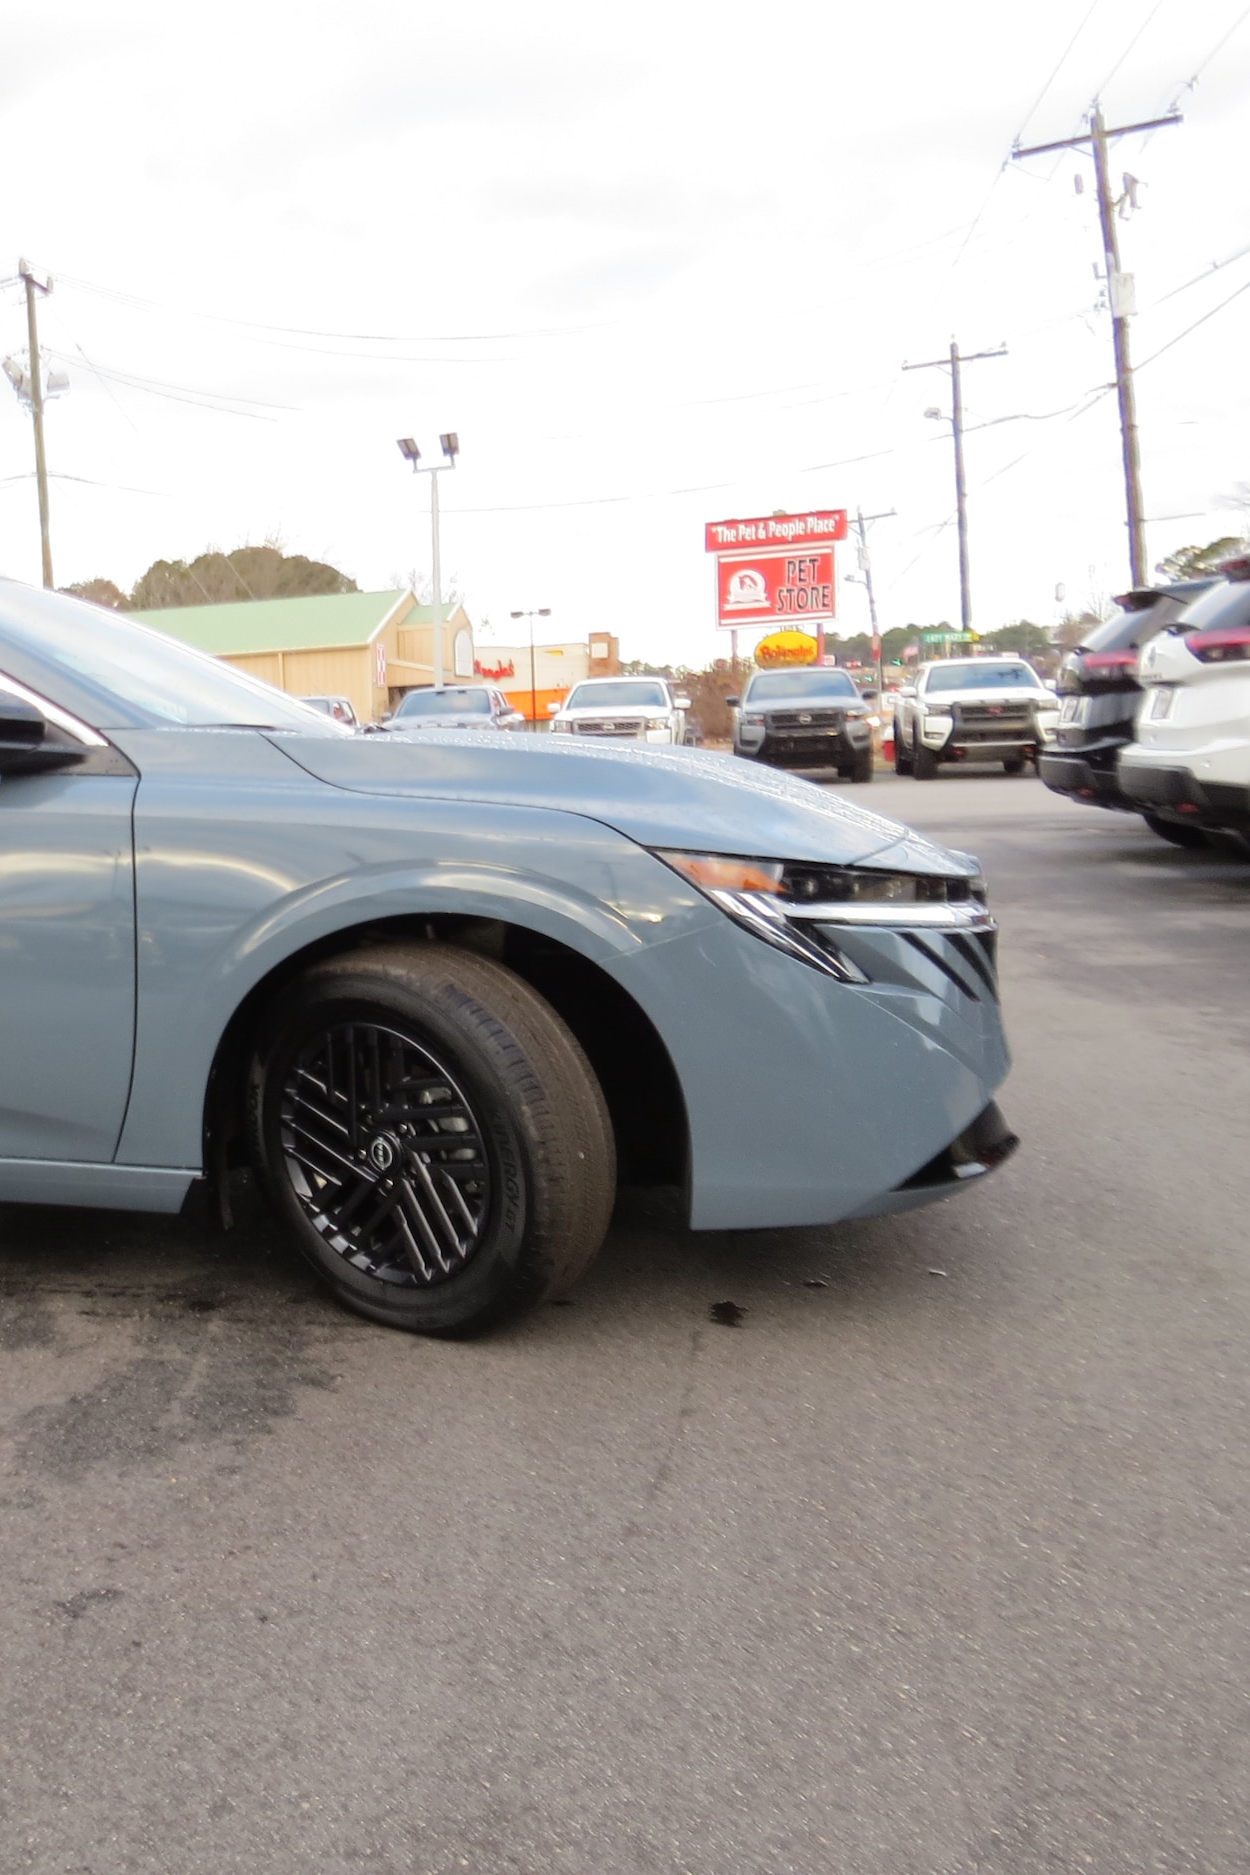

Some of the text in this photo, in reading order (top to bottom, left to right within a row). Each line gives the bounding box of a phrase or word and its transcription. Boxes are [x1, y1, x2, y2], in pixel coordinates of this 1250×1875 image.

[738, 523, 755, 541] Pet
[758, 522, 766, 539] &
[769, 519, 805, 541] People
[786, 558, 819, 585] PET
[776, 585, 831, 613] STORE
